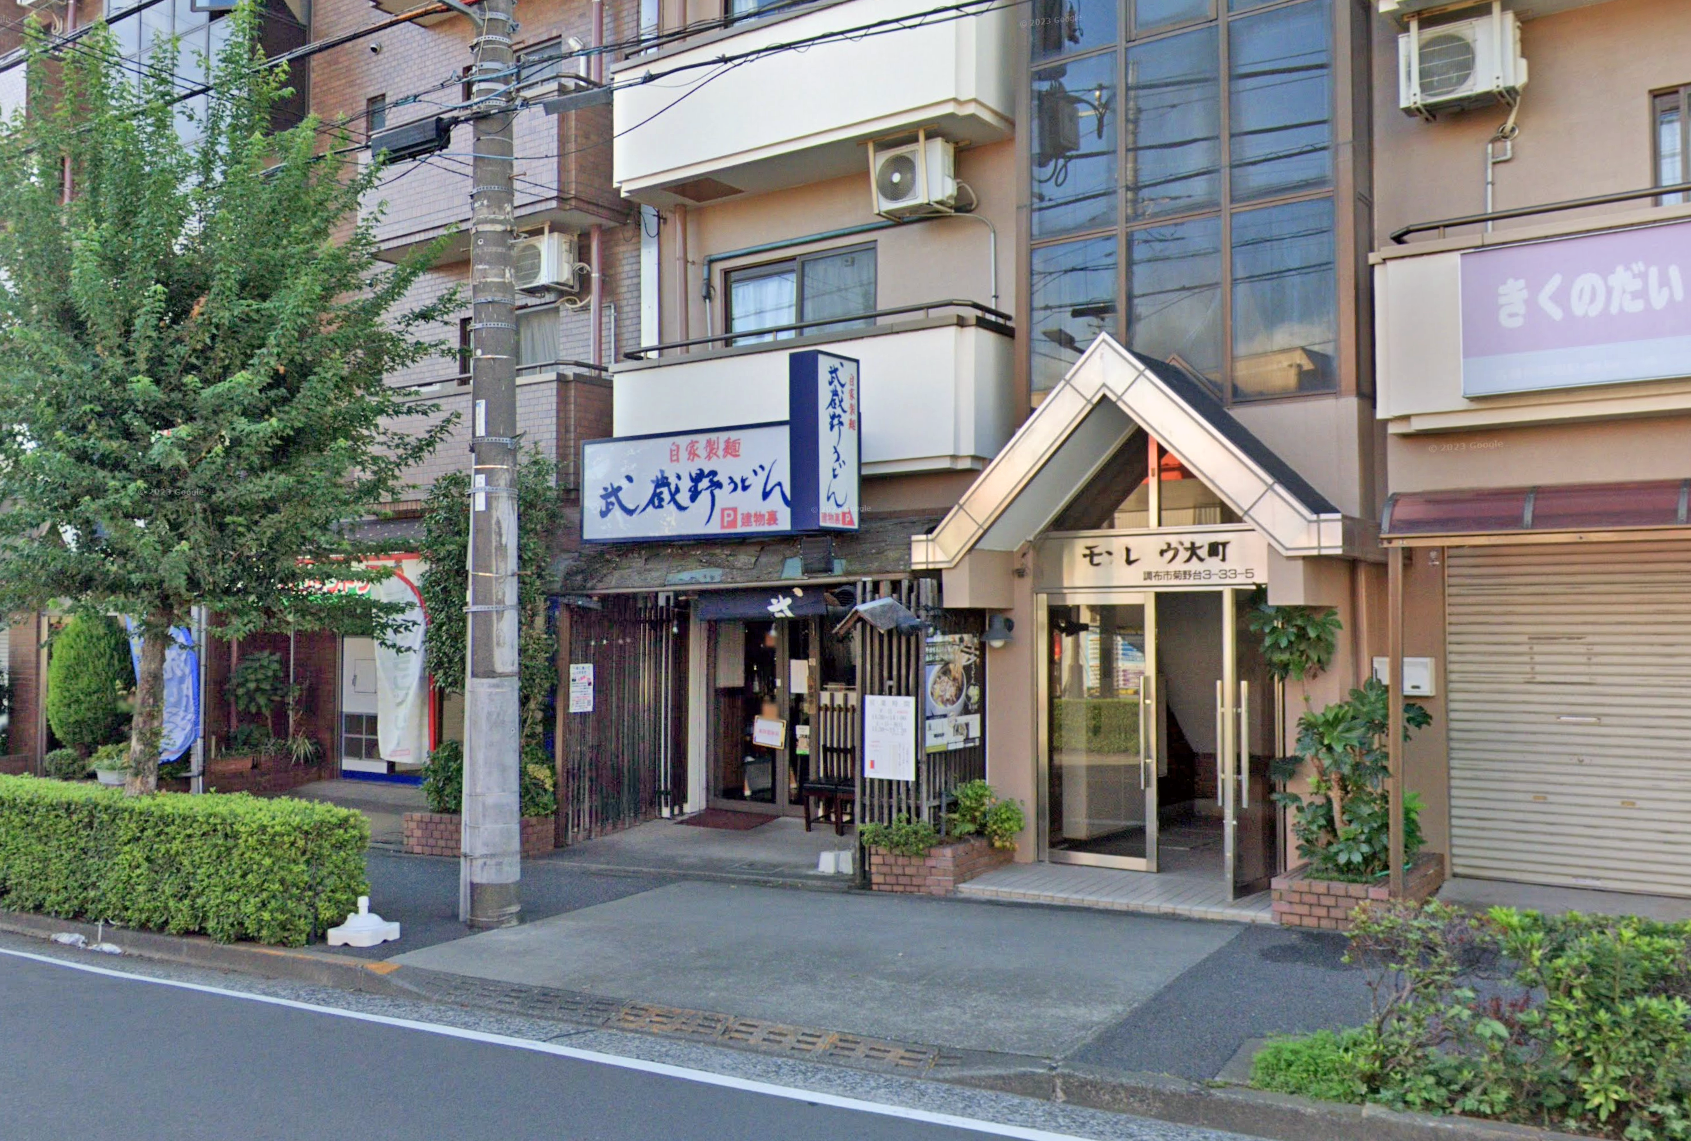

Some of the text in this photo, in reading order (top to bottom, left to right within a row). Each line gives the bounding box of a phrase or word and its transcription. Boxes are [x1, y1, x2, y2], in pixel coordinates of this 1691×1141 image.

[1498, 261, 1684, 328] きくのだい
[669, 436, 741, 463] 自家製麺
[825, 361, 848, 508] 武蔵野うどん
[600, 459, 790, 526] 武蔵野うどん
[722, 508, 778, 528] P 建物裏
